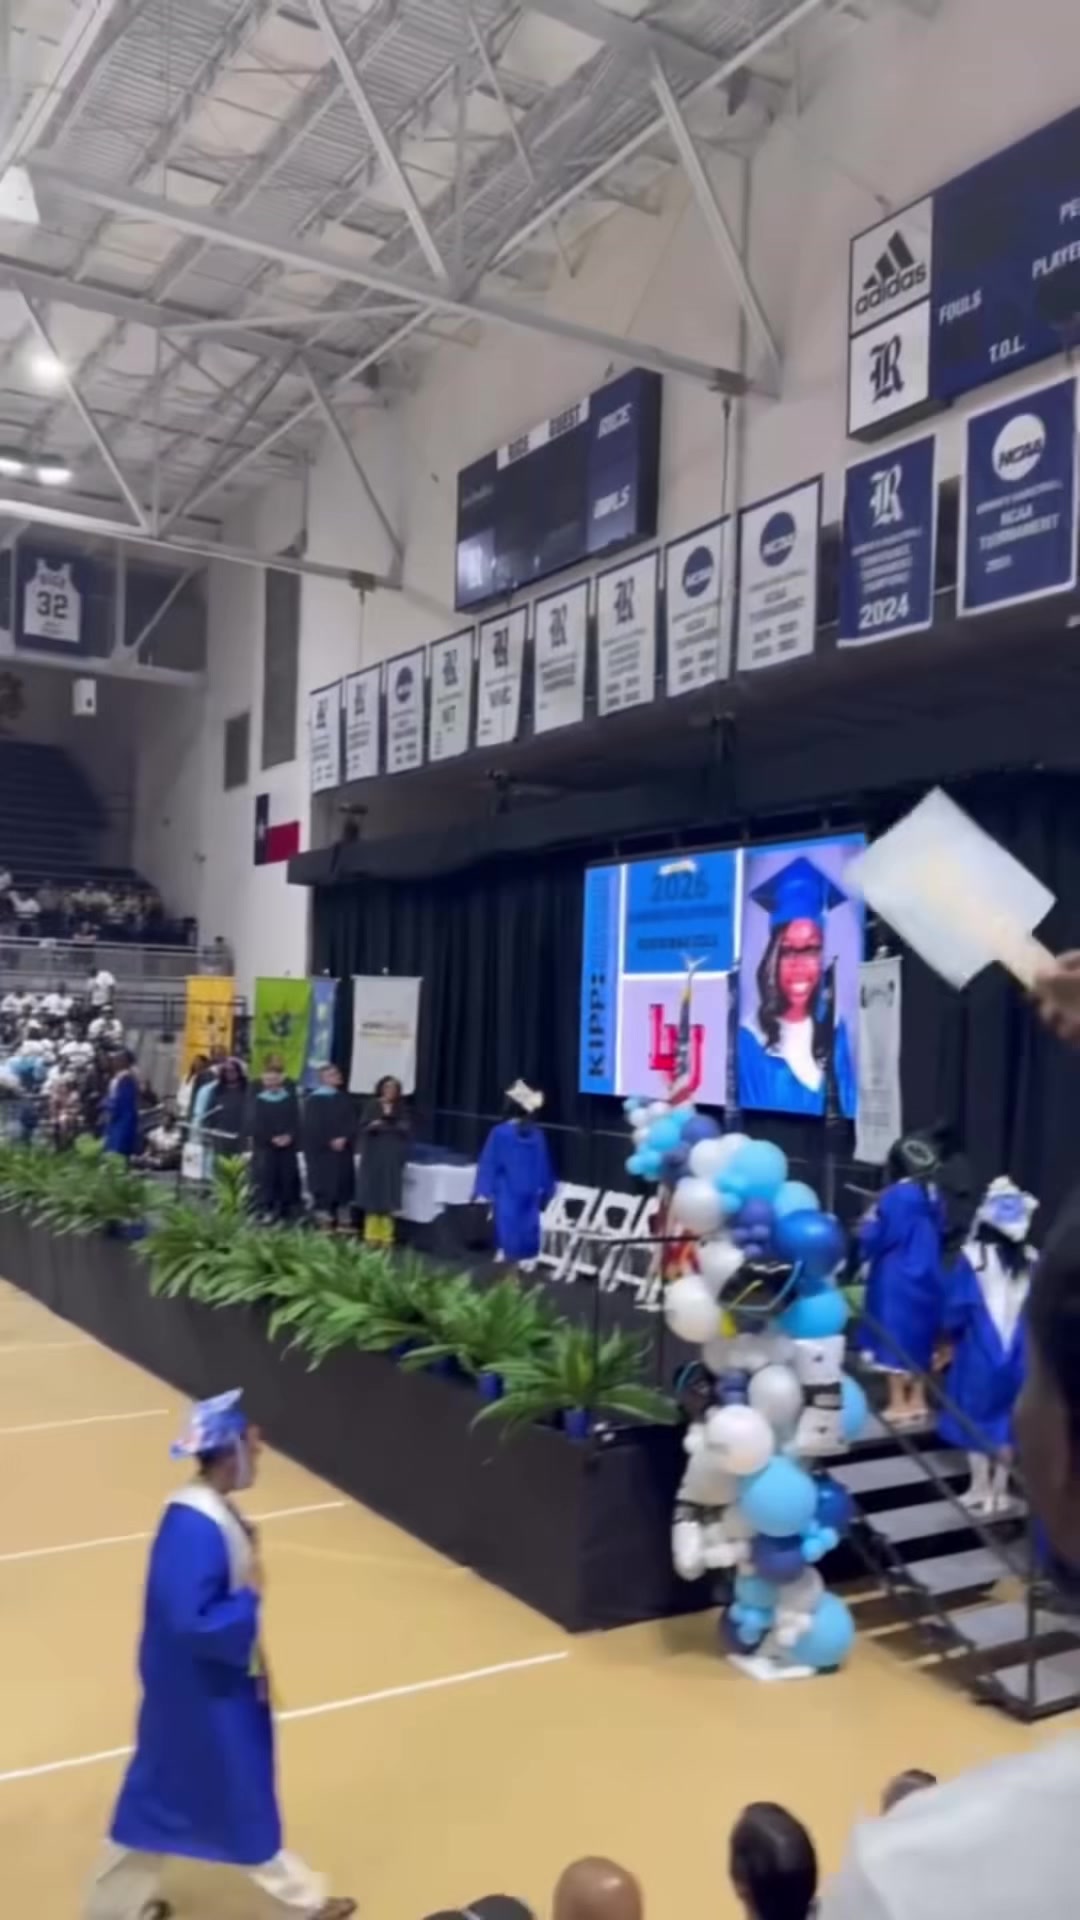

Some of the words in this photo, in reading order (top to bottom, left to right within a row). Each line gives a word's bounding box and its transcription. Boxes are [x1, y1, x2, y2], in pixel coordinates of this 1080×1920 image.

[855, 261, 927, 315] adidas
[938, 288, 982, 327] FOULS
[869, 334, 905, 404] R
[999, 437, 1042, 467] NCAA
[869, 463, 904, 528] R
[36, 590, 69, 620] 32
[857, 592, 910, 630] 2024
